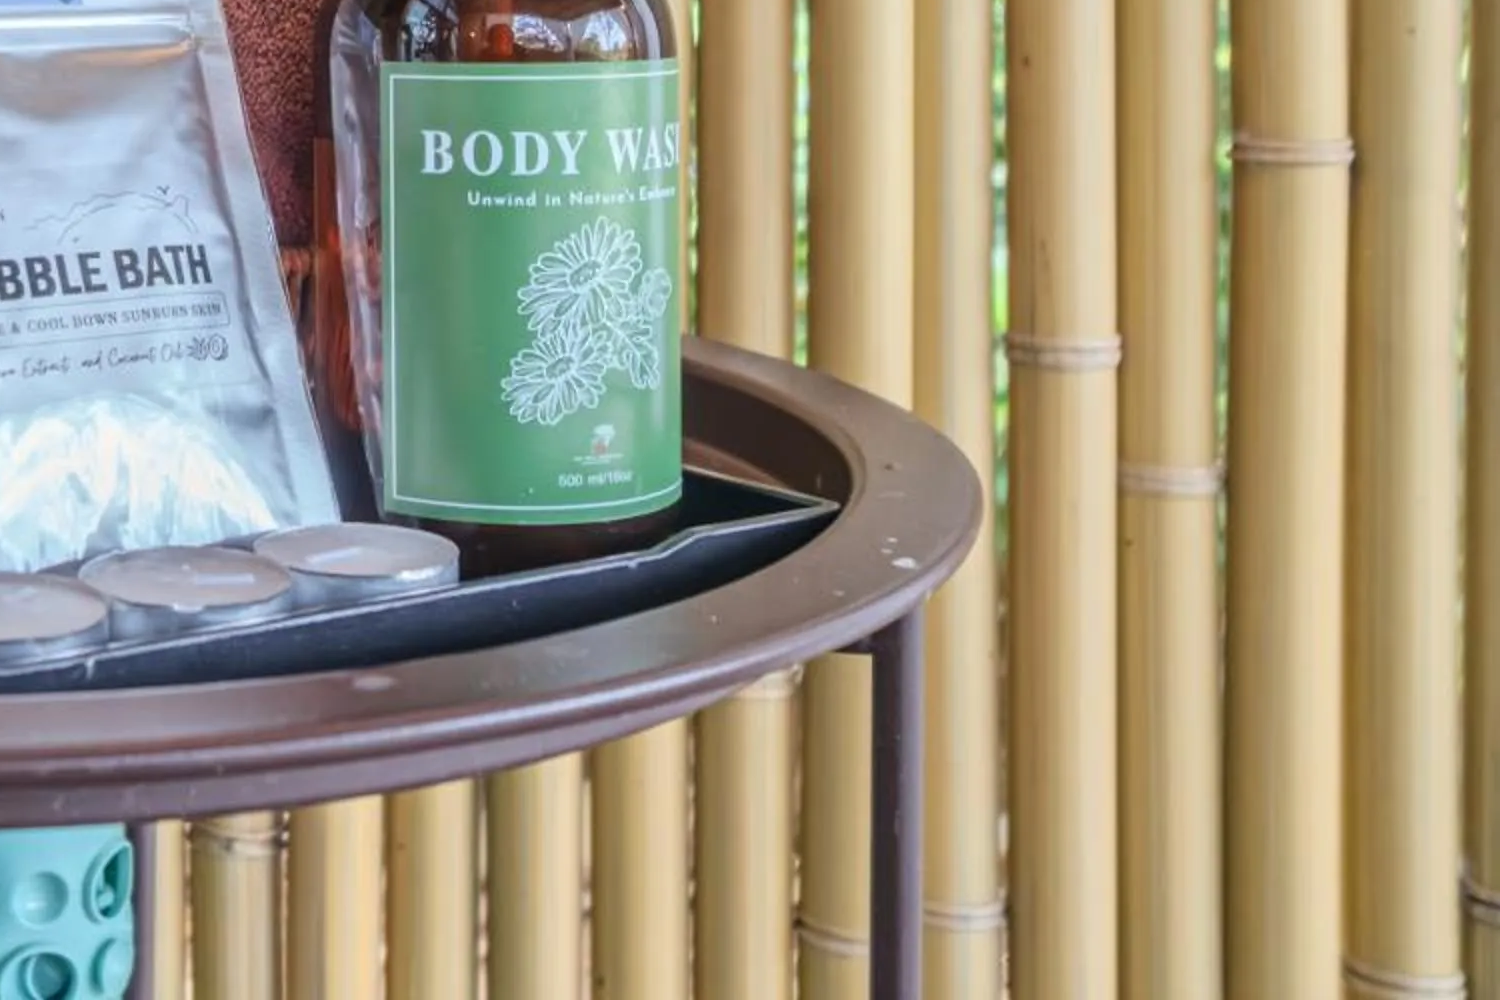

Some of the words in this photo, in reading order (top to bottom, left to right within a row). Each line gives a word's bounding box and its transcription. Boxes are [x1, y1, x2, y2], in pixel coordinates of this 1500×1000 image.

[420, 129, 588, 176] BODY
[467, 189, 537, 207] Unwind
[545, 191, 561, 206] in
[569, 186, 635, 206] Nature's
[113, 243, 213, 290] BATH
[26, 316, 70, 333] COOL
[72, 311, 118, 329] DOWN
[121, 305, 189, 324] SUNBURN
[191, 302, 222, 317] SKIN
